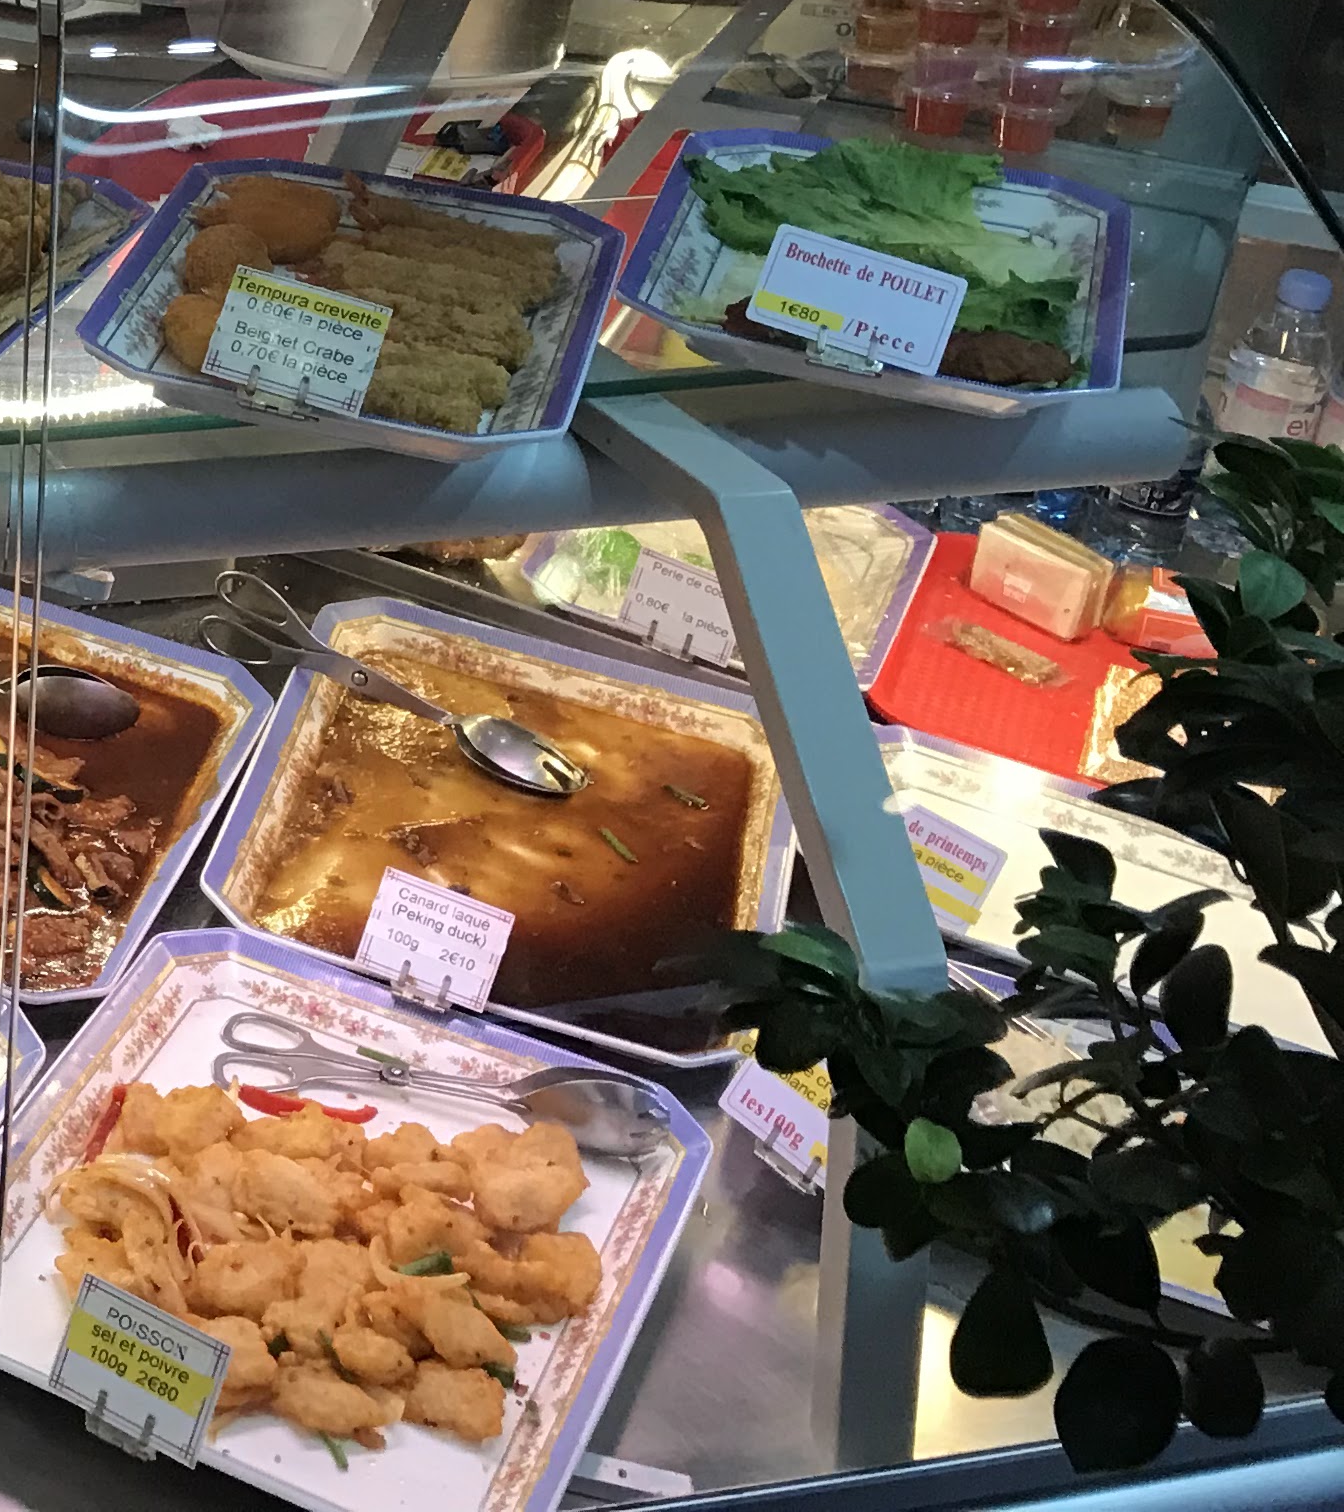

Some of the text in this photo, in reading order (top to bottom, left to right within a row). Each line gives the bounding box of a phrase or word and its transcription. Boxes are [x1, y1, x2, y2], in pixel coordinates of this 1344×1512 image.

[785, 242, 949, 306] Brochette de POULET
[237, 275, 382, 330] Tempura crevette
[298, 309, 364, 341] la pièce
[780, 300, 820, 323] 1€80
[234, 320, 355, 366] Beignet Crabe
[282, 353, 297, 369] la
[301, 360, 348, 384] pièce
[652, 561, 702, 589] Perle de
[682, 611, 694, 623] la
[909, 820, 989, 873] de printemps
[925, 853, 965, 883] pièce
[391, 904, 487, 950] (Peking duck)
[398, 886, 491, 931] Canard laqué
[386, 927, 476, 971] 100g 2€10
[91, 1322, 190, 1385] sel et poivre
[106, 1306, 189, 1362] POISSON
[89, 1344, 179, 1403] 100g 2€80
